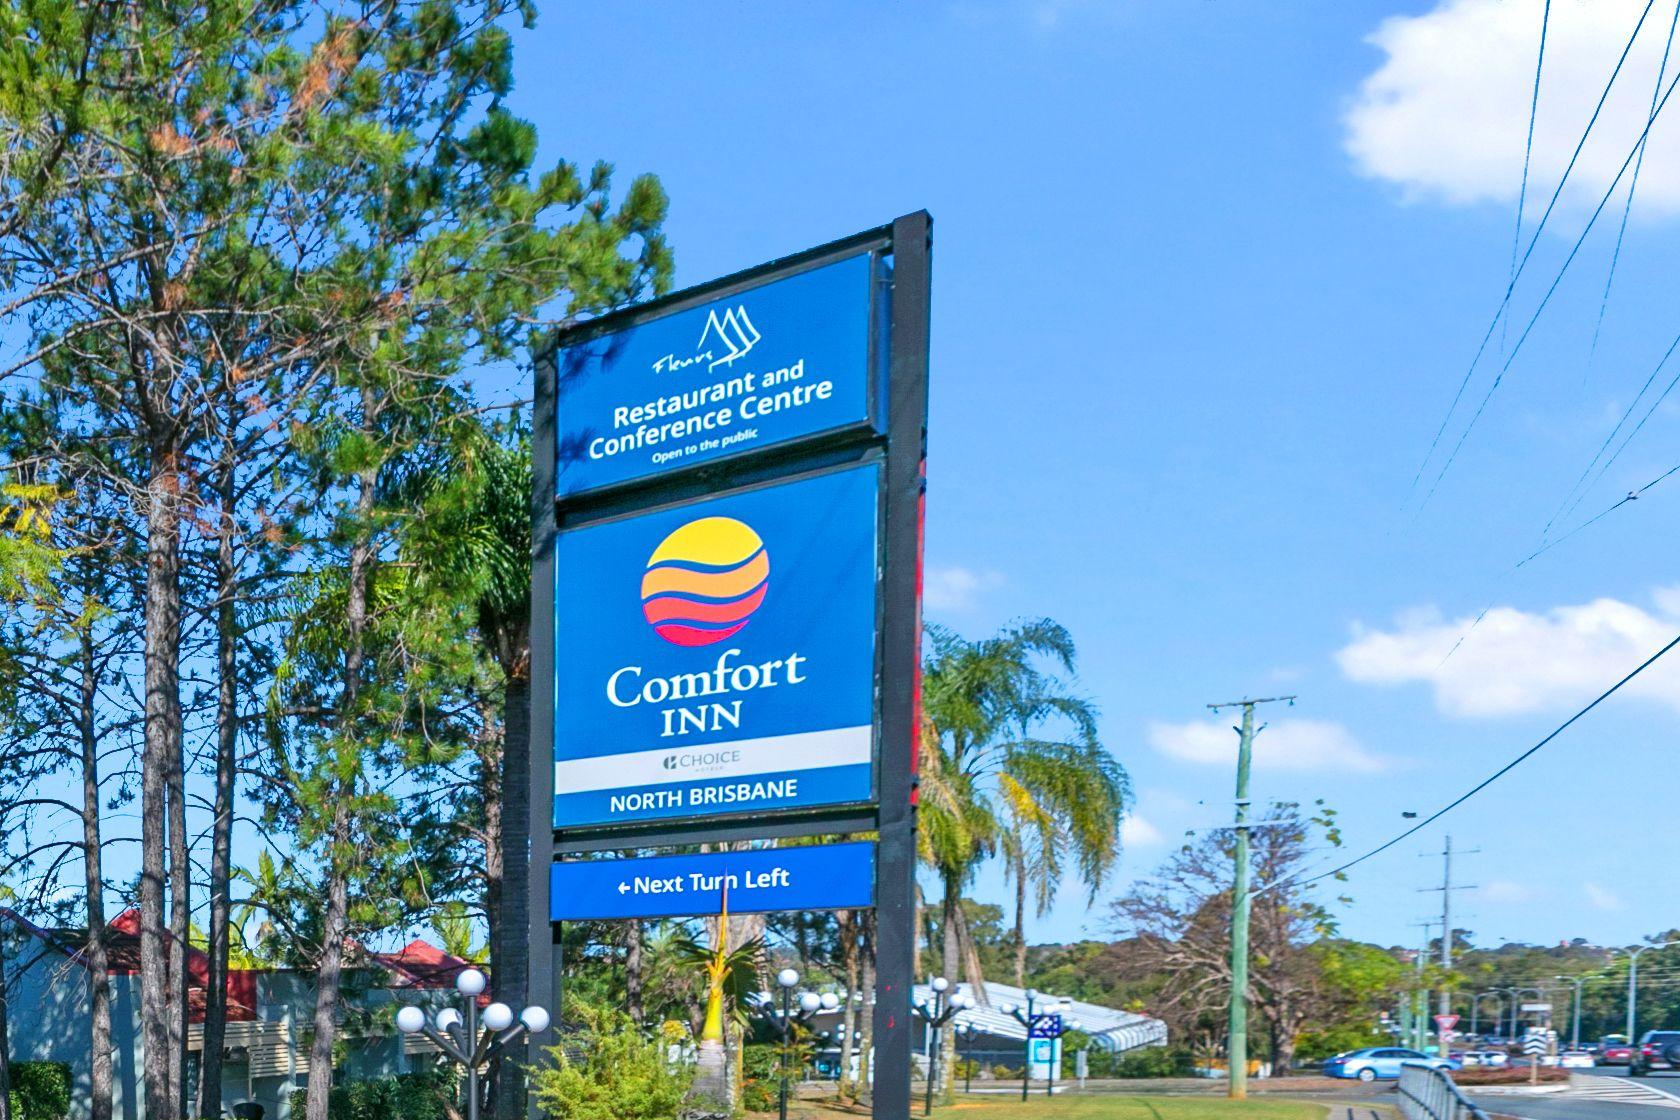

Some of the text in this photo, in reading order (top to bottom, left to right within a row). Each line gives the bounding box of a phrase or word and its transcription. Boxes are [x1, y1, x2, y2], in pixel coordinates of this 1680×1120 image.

[614, 359, 804, 429] Restaurant and
[589, 380, 833, 460] Conference Centre
[652, 428, 758, 464] Open to the public
[606, 648, 807, 707] Comfort
[660, 701, 743, 737] INN
[680, 750, 740, 767] CHOICE
[610, 779, 798, 813] NORTH BRISBANE
[634, 867, 790, 894] Next Turn Left
